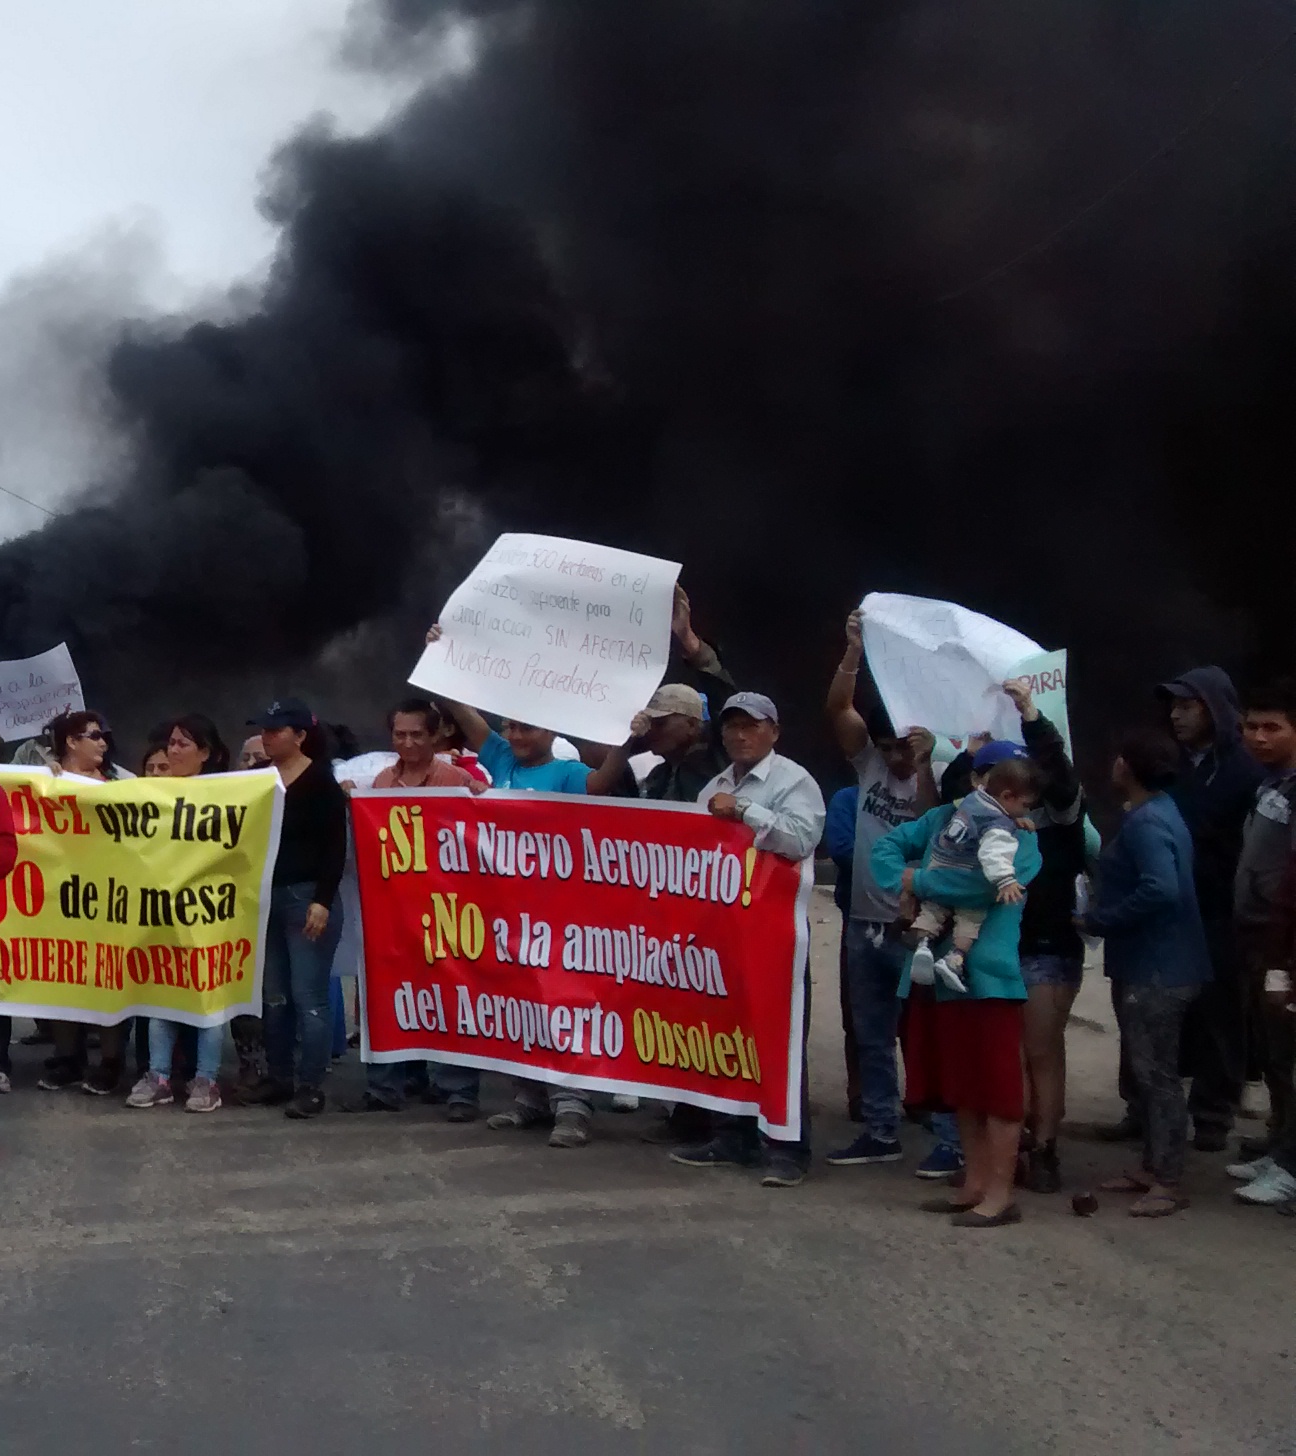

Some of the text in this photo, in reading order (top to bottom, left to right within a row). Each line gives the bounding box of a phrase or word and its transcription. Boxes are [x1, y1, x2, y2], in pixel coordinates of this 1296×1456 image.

[611, 571, 627, 588] en
[632, 572, 650, 595] el
[545, 624, 569, 649] SIN
[579, 633, 652, 671] AFECTAR
[96, 799, 160, 845] que
[171, 797, 248, 850] hay
[438, 821, 469, 873] al
[477, 821, 573, 880] Nuevo
[581, 828, 758, 907] Aeropuerto!
[60, 873, 98, 921] de
[107, 876, 129, 925] la
[139, 881, 237, 928] mesa
[95, 937, 252, 993] FAVORECER?
[492, 918, 513, 963] a
[519, 912, 552, 968] la
[562, 923, 728, 997] ampliación
[394, 982, 762, 1085] del Aeropuerto Obsoleto
